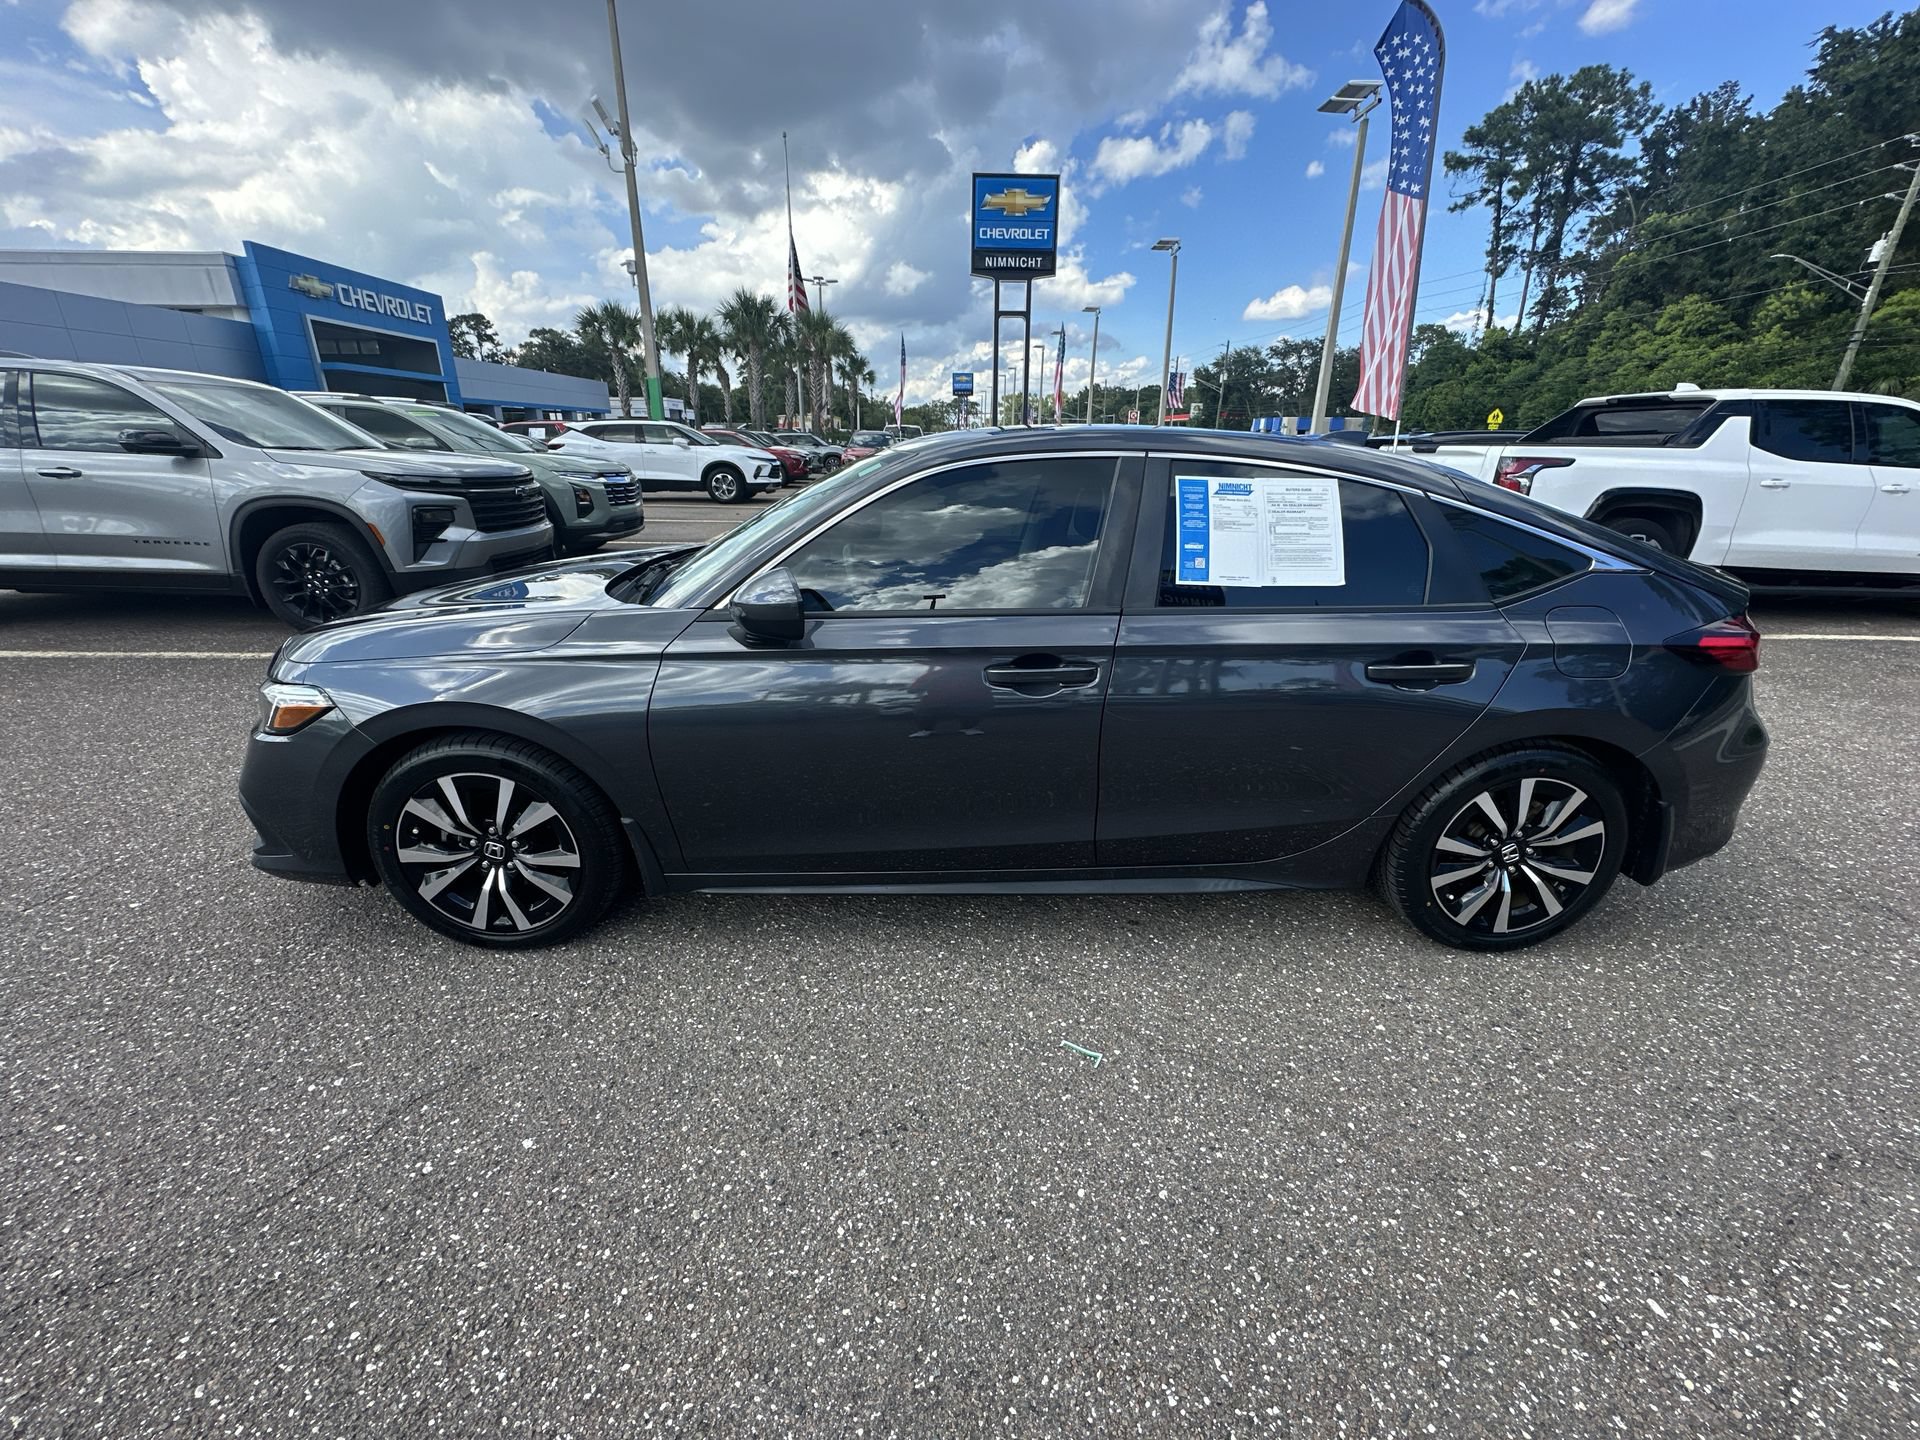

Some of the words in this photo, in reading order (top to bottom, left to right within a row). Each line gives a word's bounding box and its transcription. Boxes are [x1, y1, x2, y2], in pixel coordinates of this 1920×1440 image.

[979, 227, 1050, 240] CHEVROLET
[985, 256, 1042, 268] NIMNICHT
[335, 282, 433, 325] CHEVROLET
[1218, 482, 1252, 491] NIMNICHT
[133, 539, 211, 547] TRAVERSE
